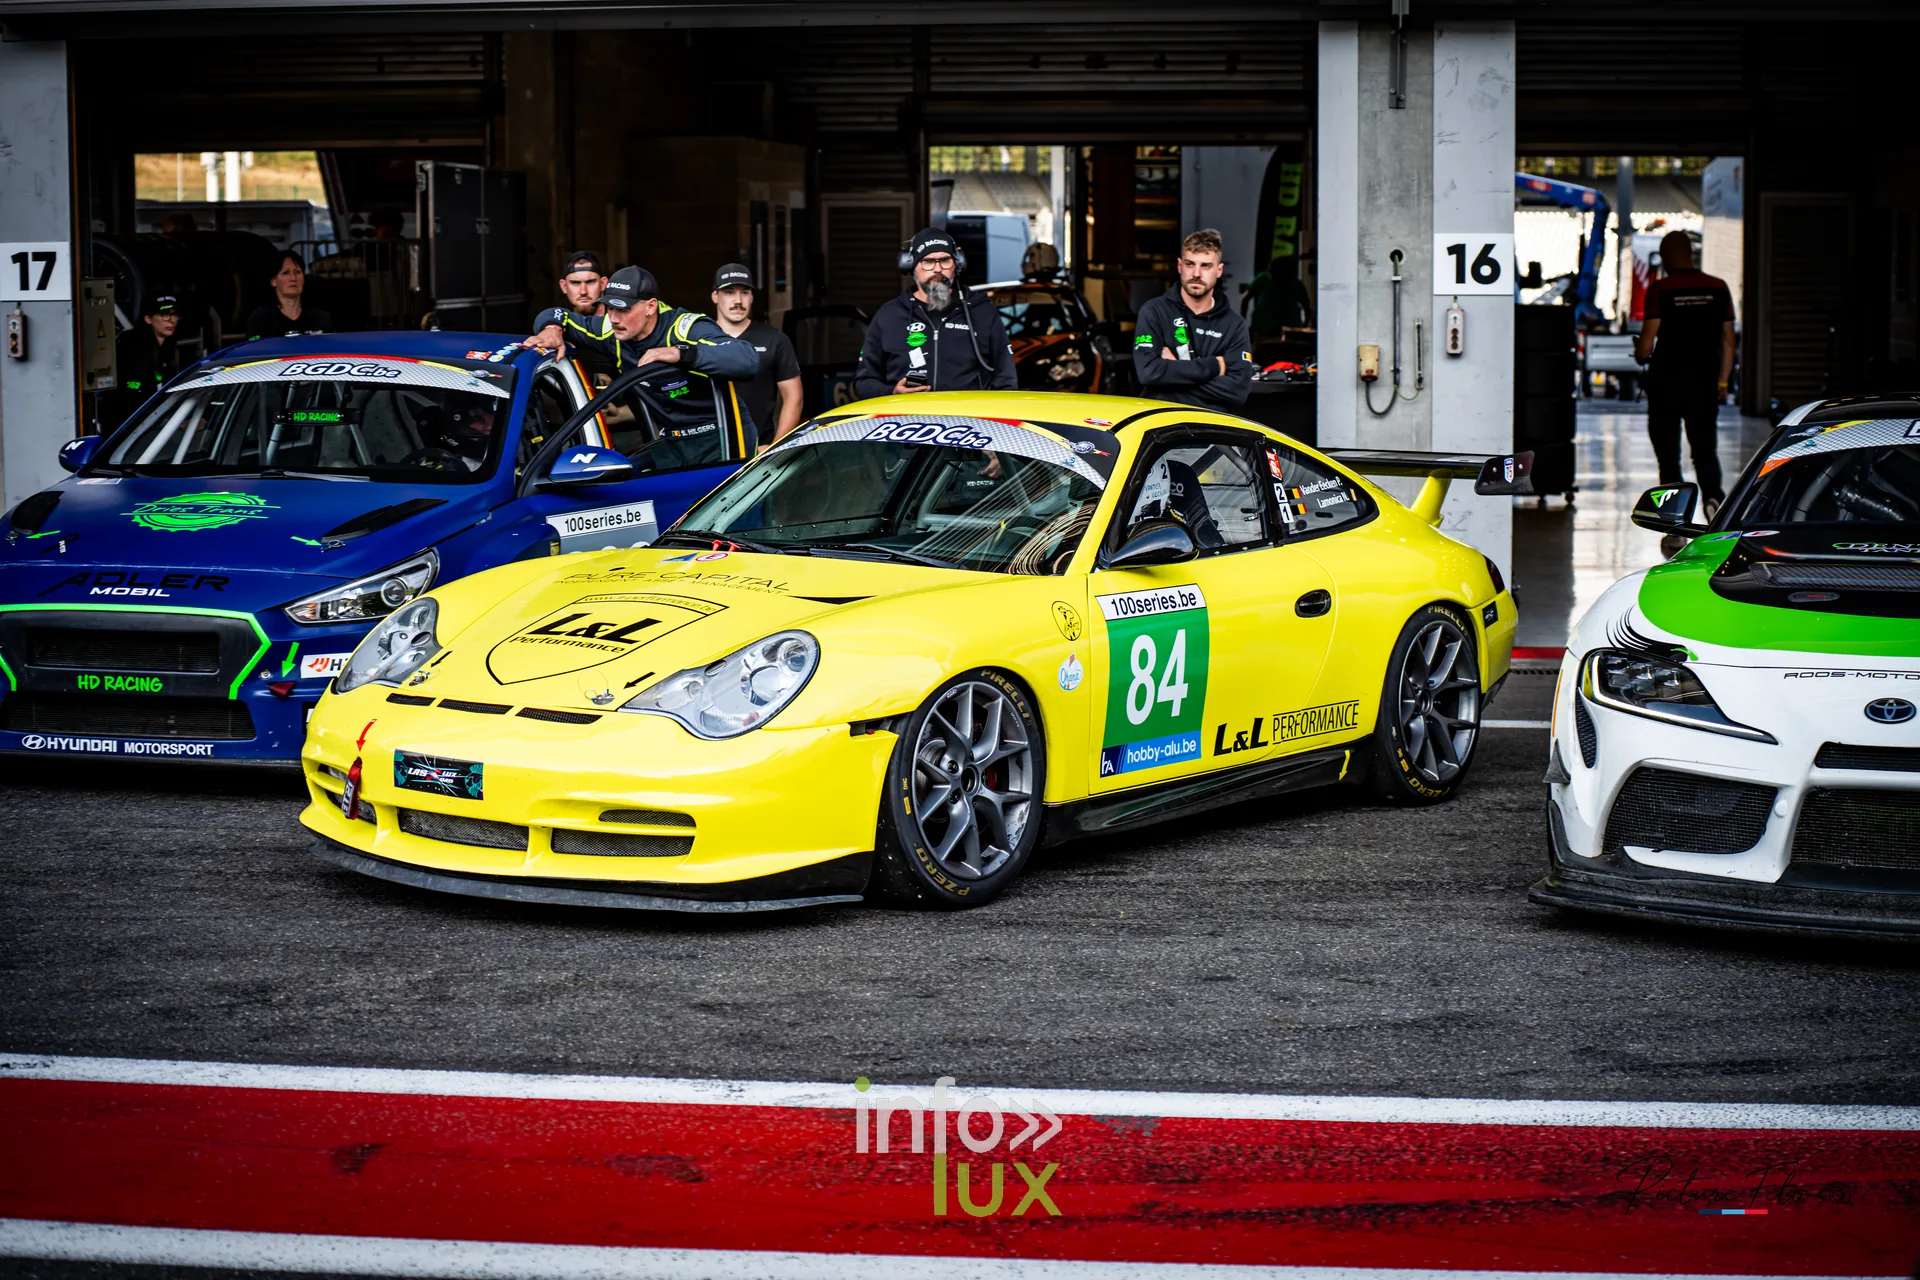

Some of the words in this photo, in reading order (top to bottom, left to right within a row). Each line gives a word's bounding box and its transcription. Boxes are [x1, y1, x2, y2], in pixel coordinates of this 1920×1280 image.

[11, 251, 57, 291] 17
[1446, 243, 1502, 285] 16
[280, 362, 402, 379] BGDC.be
[293, 411, 308, 422] HD
[308, 412, 340, 422] RACING
[864, 422, 990, 449] BGDC.be
[1276, 485, 1285, 501] 2
[564, 508, 642, 533] 100series.be
[1282, 504, 1290, 521] 1
[36, 571, 231, 597] ADLER
[89, 587, 171, 598] MOBIL
[564, 571, 657, 580] PURE
[659, 571, 790, 592] CAPITAL
[1110, 590, 1198, 616] 100series.be
[525, 612, 664, 645] L&L
[509, 635, 627, 655] Performance
[77, 674, 100, 690] HD
[104, 675, 164, 693] RACING
[1126, 628, 1189, 726] 84
[980, 668, 1029, 720] PIRELLI
[1272, 702, 1360, 742] PERFORMANCE
[46, 736, 118, 753] HYUNDAI
[124, 741, 214, 756] MOTORSPORT
[1212, 717, 1269, 757] L&L
[1126, 738, 1198, 764] hobby-alu.be
